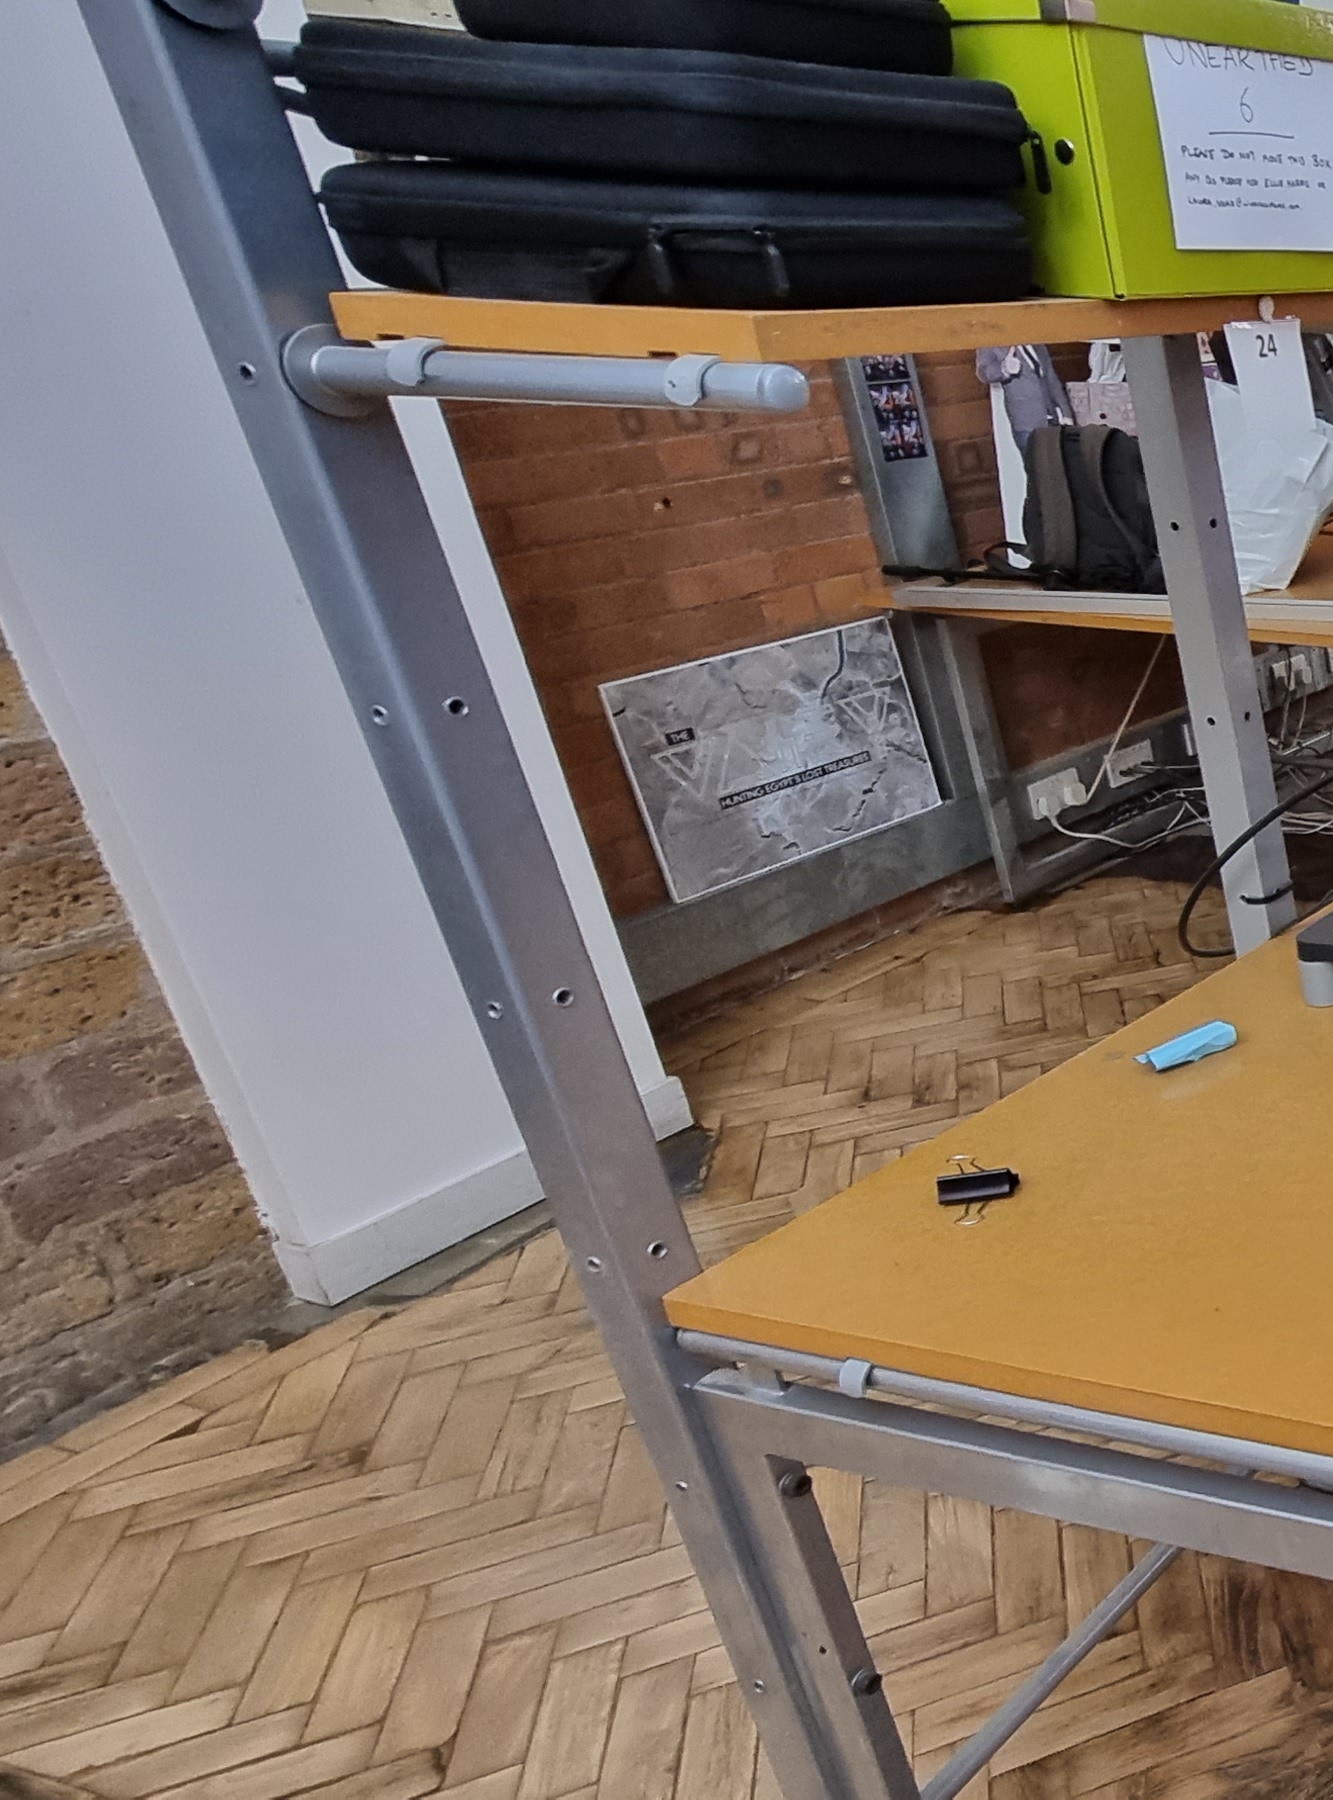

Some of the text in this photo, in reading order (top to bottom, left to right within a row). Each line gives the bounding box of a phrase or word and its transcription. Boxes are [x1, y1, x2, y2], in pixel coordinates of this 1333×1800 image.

[1240, 86, 1254, 123] 6
[1239, 151, 1255, 161] NOT
[1255, 333, 1278, 358] 24
[670, 731, 691, 744] THE
[720, 787, 765, 808] HUNTING
[823, 753, 870, 774] TREASURES
